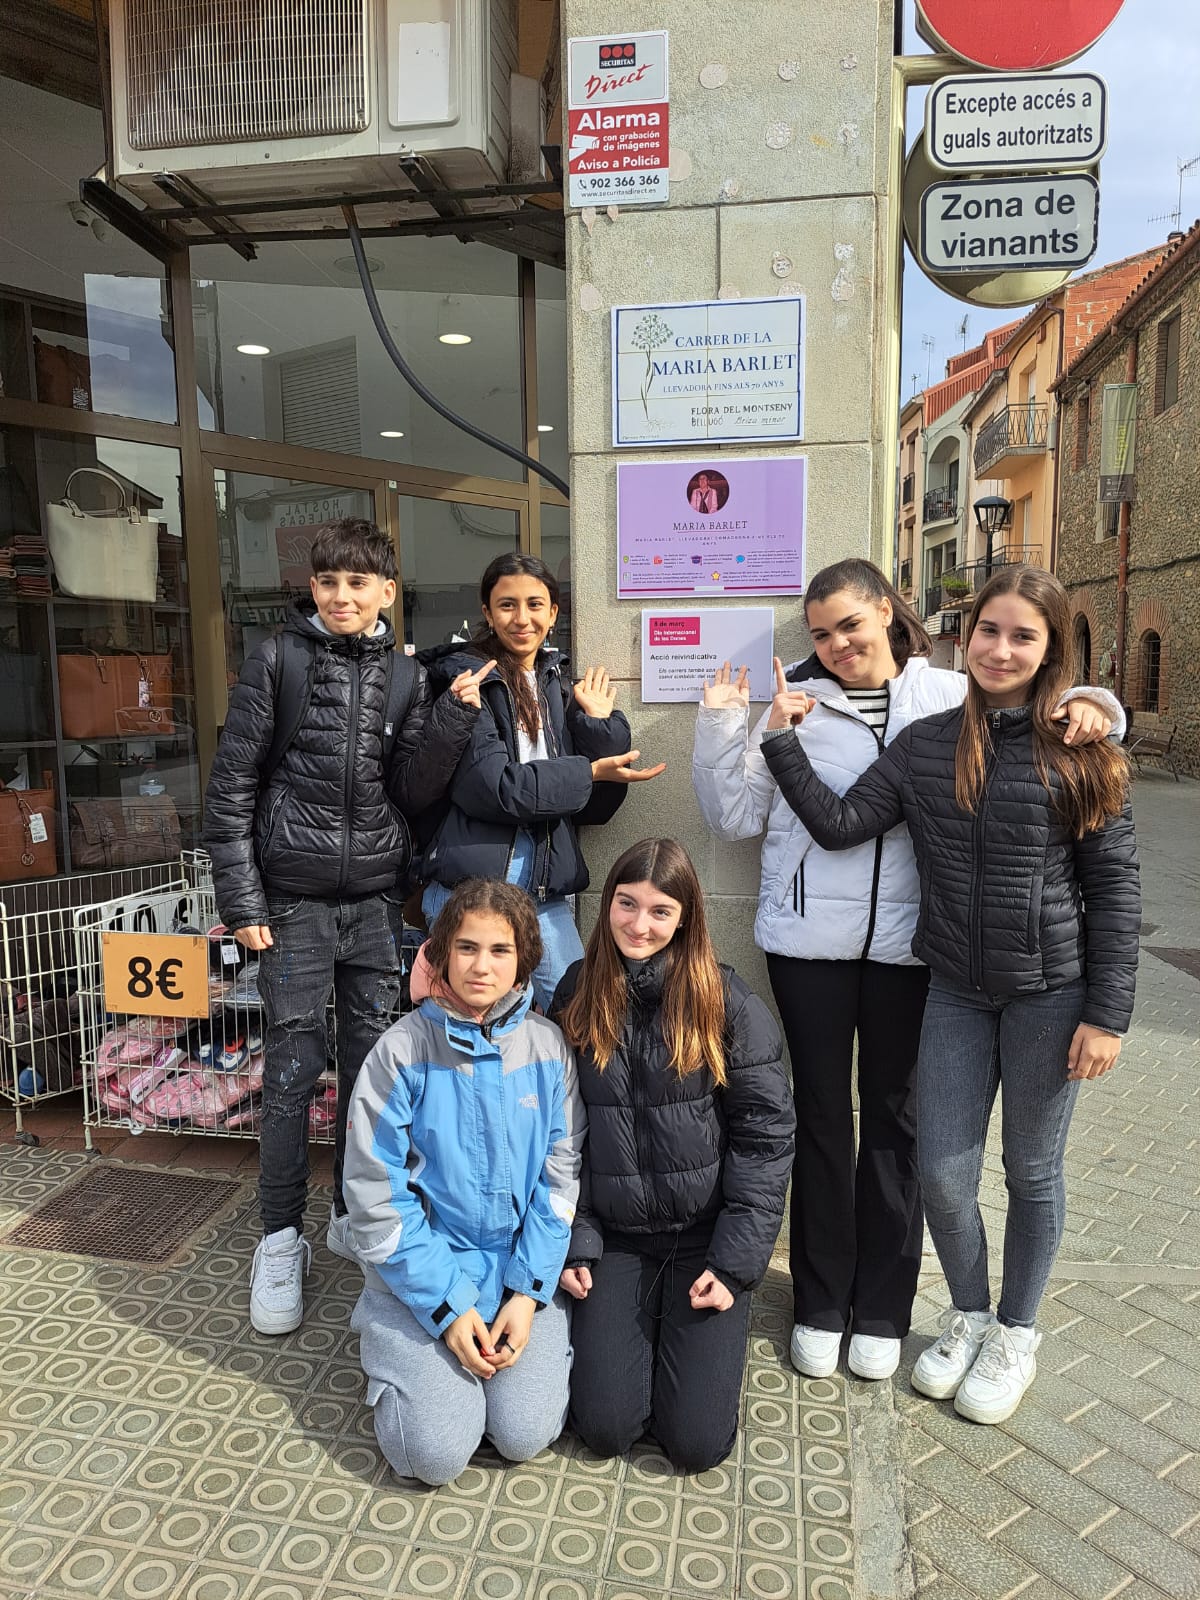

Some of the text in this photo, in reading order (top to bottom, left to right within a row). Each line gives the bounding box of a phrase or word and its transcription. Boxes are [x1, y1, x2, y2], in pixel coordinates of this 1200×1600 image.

[601, 58, 634, 67] SECURITAS
[584, 64, 655, 99] Direct
[946, 88, 1092, 117] Excepte accés a
[577, 111, 660, 131] Alarma
[619, 131, 660, 142] grabación
[943, 124, 1093, 154] guals autoritzats
[603, 141, 660, 152] de imágenes
[578, 155, 660, 170] Aviso a Policía
[590, 175, 660, 189] 902 366 366
[581, 188, 657, 198] www.securitasdirect.es
[940, 188, 1075, 221] Zona de
[941, 228, 1079, 259] vianants
[675, 332, 773, 348] CARRER DE LA
[652, 354, 796, 376] MARIA BARLET
[663, 384, 712, 393] LLEVADORA
[714, 382, 733, 390] FINS
[735, 381, 751, 389] ALS
[762, 379, 785, 388] ANYS
[691, 403, 793, 415] FLORA DEL MONTSENY
[673, 520, 748, 531] MARIA BARLET
[650, 653, 670, 661] Acció
[128, 957, 183, 1000] 8€
